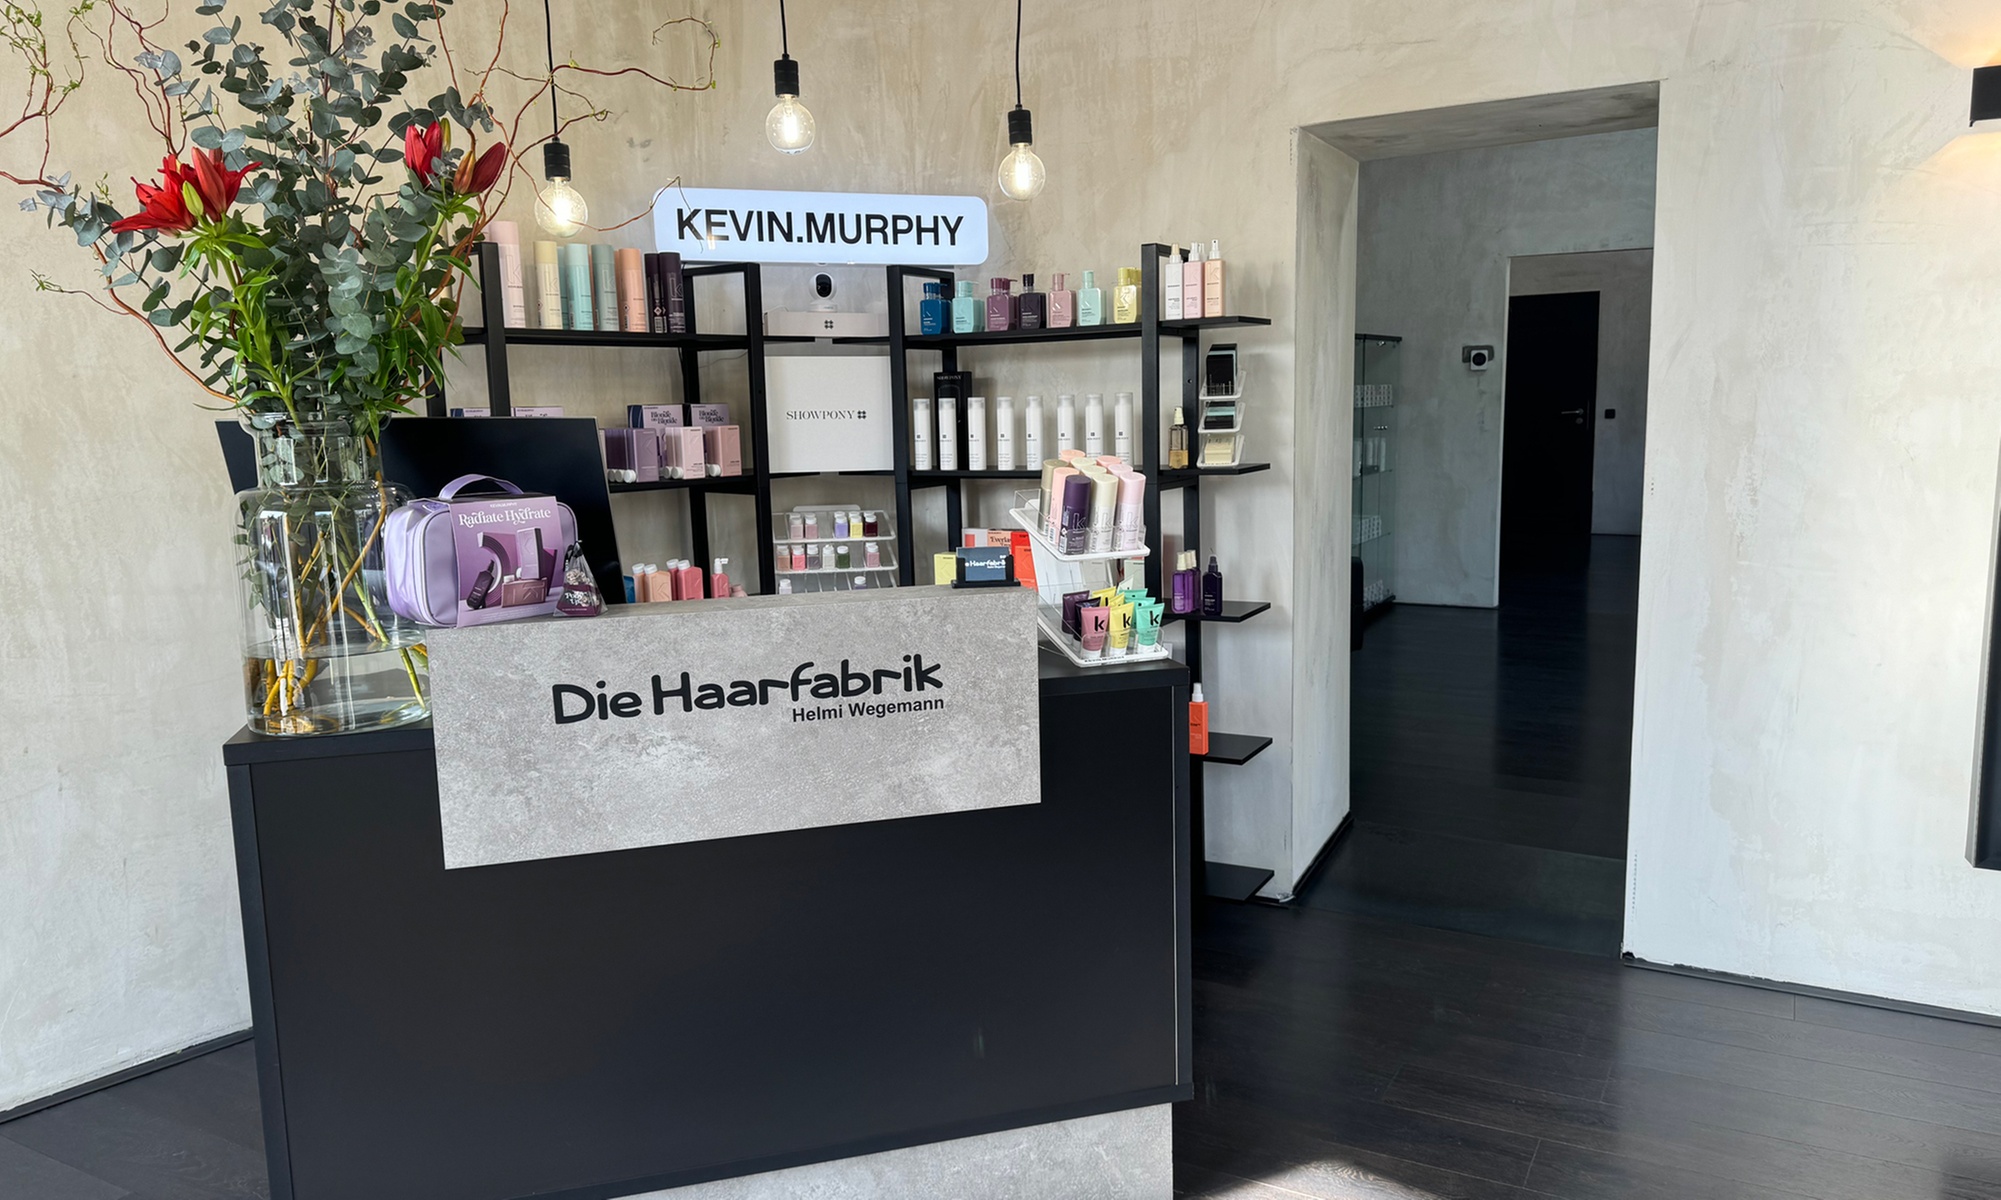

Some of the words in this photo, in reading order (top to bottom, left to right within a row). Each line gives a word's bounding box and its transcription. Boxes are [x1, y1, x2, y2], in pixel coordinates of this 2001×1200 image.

[676, 208, 964, 246] KEVIN.MURPHY
[786, 410, 855, 420] SHOWPONY
[458, 510, 504, 528] Radiate
[504, 507, 552, 525] Hydrate
[552, 680, 642, 725] Die
[651, 654, 943, 716] Haarfabrik
[792, 704, 843, 722] Helmi
[848, 699, 944, 718] Wegemann
